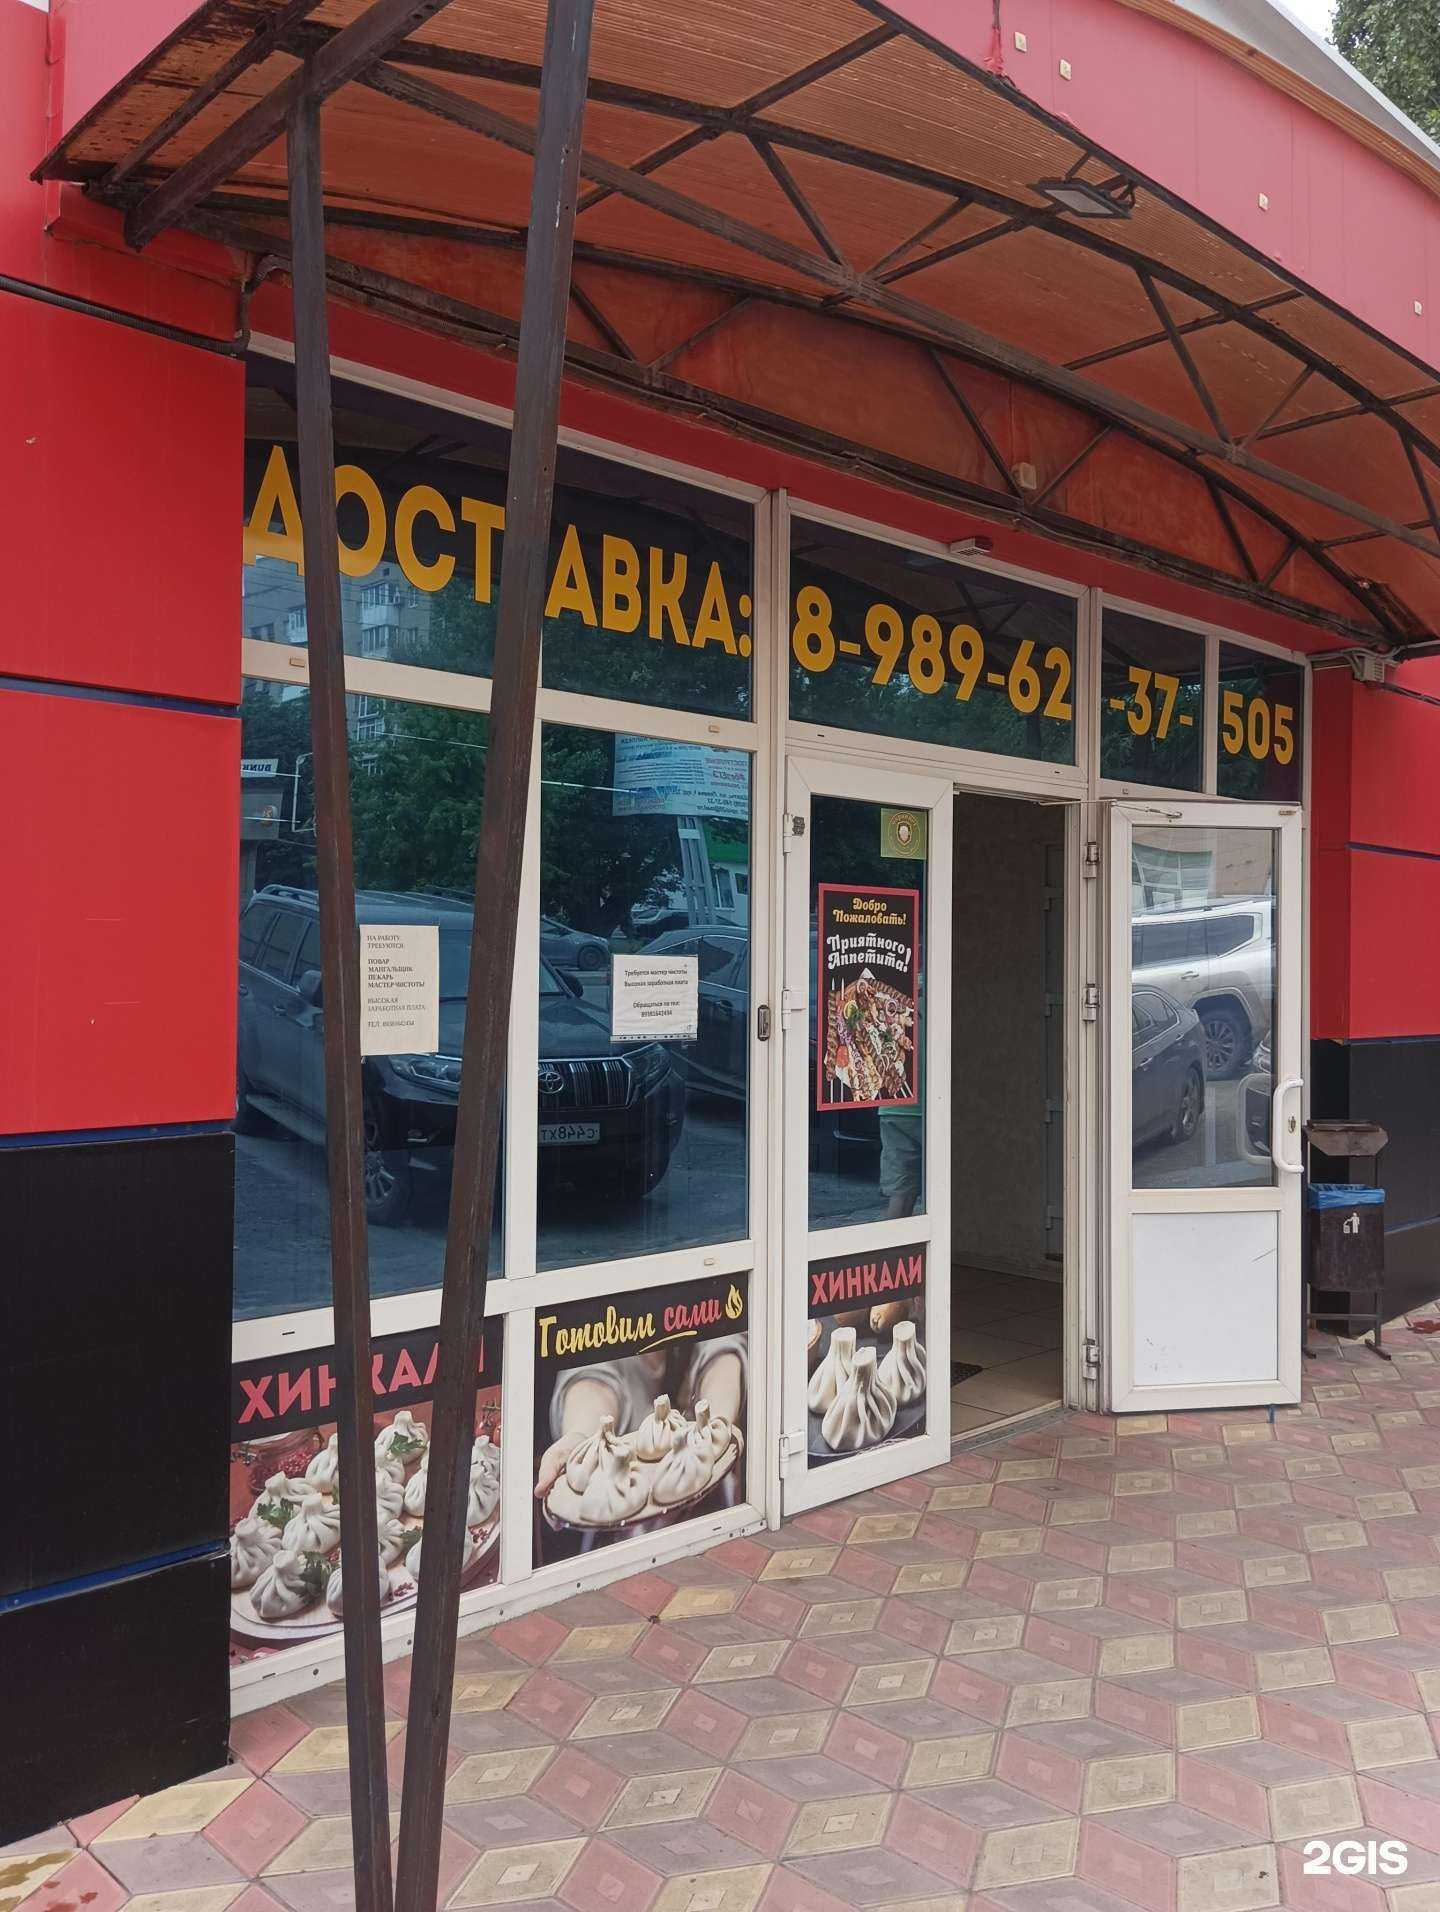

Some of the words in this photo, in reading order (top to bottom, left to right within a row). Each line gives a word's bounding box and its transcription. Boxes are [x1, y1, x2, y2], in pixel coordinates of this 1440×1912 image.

[1222, 690, 1295, 765] 505
[833, 909, 907, 926] Пожаловать!
[853, 898, 887, 913] Добро
[826, 932, 905, 955] Приятного
[811, 1254, 922, 1305] ХИНКАЛИ
[539, 1305, 656, 1358] Готовим
[664, 1298, 722, 1332] сами
[238, 1335, 484, 1424] ХИНКА
